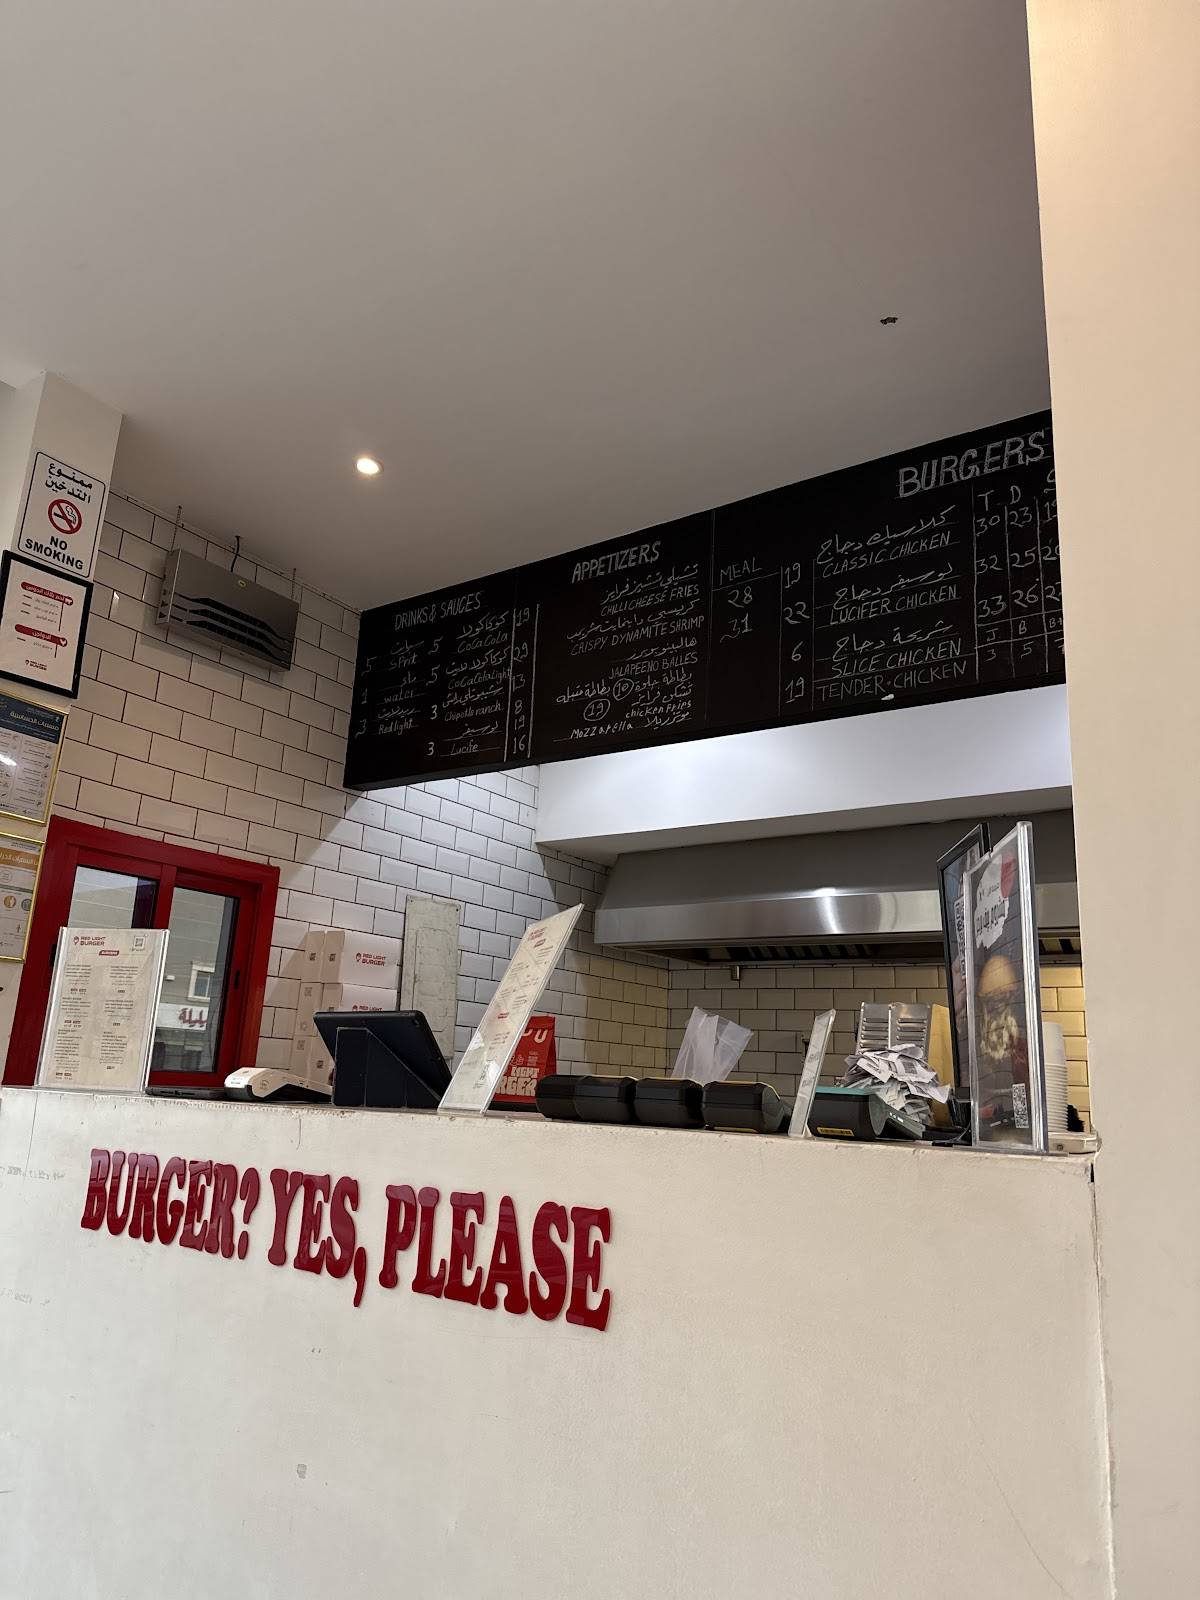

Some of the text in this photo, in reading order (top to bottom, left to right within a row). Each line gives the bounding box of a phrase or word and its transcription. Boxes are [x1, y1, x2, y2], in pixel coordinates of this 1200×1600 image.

[48, 462, 93, 490] ممنوع
[899, 430, 1045, 499] BURGERS
[45, 475, 91, 504] التدخين
[977, 485, 1022, 512] T D
[976, 514, 1001, 536] 30
[1009, 506, 1033, 528] 23
[25, 538, 84, 571] SMOKING
[50, 535, 68, 551] NO
[822, 530, 951, 579] CLASSIC CHICKEN
[571, 540, 662, 584] APPETIZERS
[719, 556, 763, 586] MEAL
[784, 562, 801, 589] 19
[975, 554, 1004, 576] 32
[1010, 546, 1037, 568] 25
[394, 605, 429, 631] DRINKS
[440, 592, 482, 619] SAUCES
[601, 583, 700, 617] CHILLI CHEESE FRIES
[727, 585, 753, 608] 28
[829, 583, 957, 626] LUCIFER CHICKEN
[977, 595, 1008, 618] 33
[1012, 584, 1038, 608] 26
[782, 601, 811, 625] 22
[570, 615, 705, 656] CRISPY DYNAMITE SHRIMP
[791, 641, 804, 661] 6
[831, 638, 961, 678] SLICE CHICKEN
[785, 676, 805, 703] 19
[815, 660, 968, 702] TENDER CHICKEN
[513, 700, 523, 715] 8
[427, 741, 436, 756] 3
[512, 735, 527, 755] 16
[361, 959, 385, 967] BURGER
[81, 1148, 612, 1332] BURGER? YES, PLEASE
